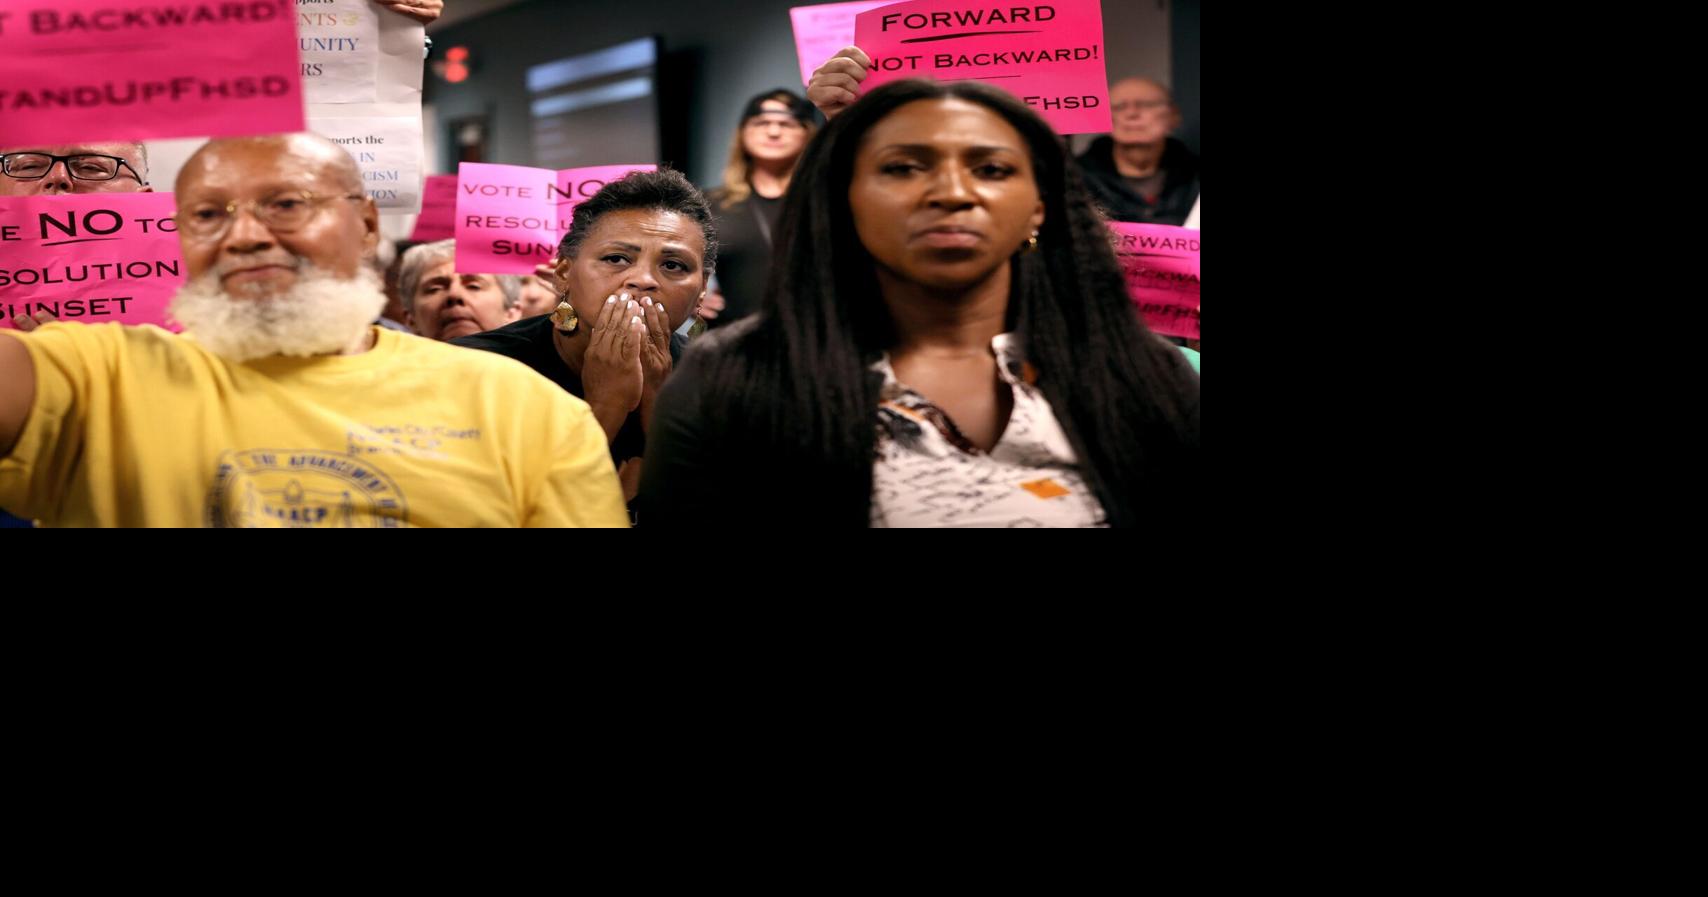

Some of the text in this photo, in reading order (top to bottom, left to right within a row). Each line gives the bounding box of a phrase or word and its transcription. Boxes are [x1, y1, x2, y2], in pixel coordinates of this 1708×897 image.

[297, 13, 337, 26] NTS
[882, 5, 1056, 32] FORWARD
[296, 38, 359, 51] UNITY
[934, 45, 1099, 69] BACKWARD!
[365, 135, 384, 145] the
[463, 183, 533, 199] VOTE
[38, 209, 124, 240] NO
[134, 217, 178, 234] TO
[491, 239, 553, 256] SUN
[1113, 235, 1200, 252] RWARD
[0, 296, 133, 320] UNSET
